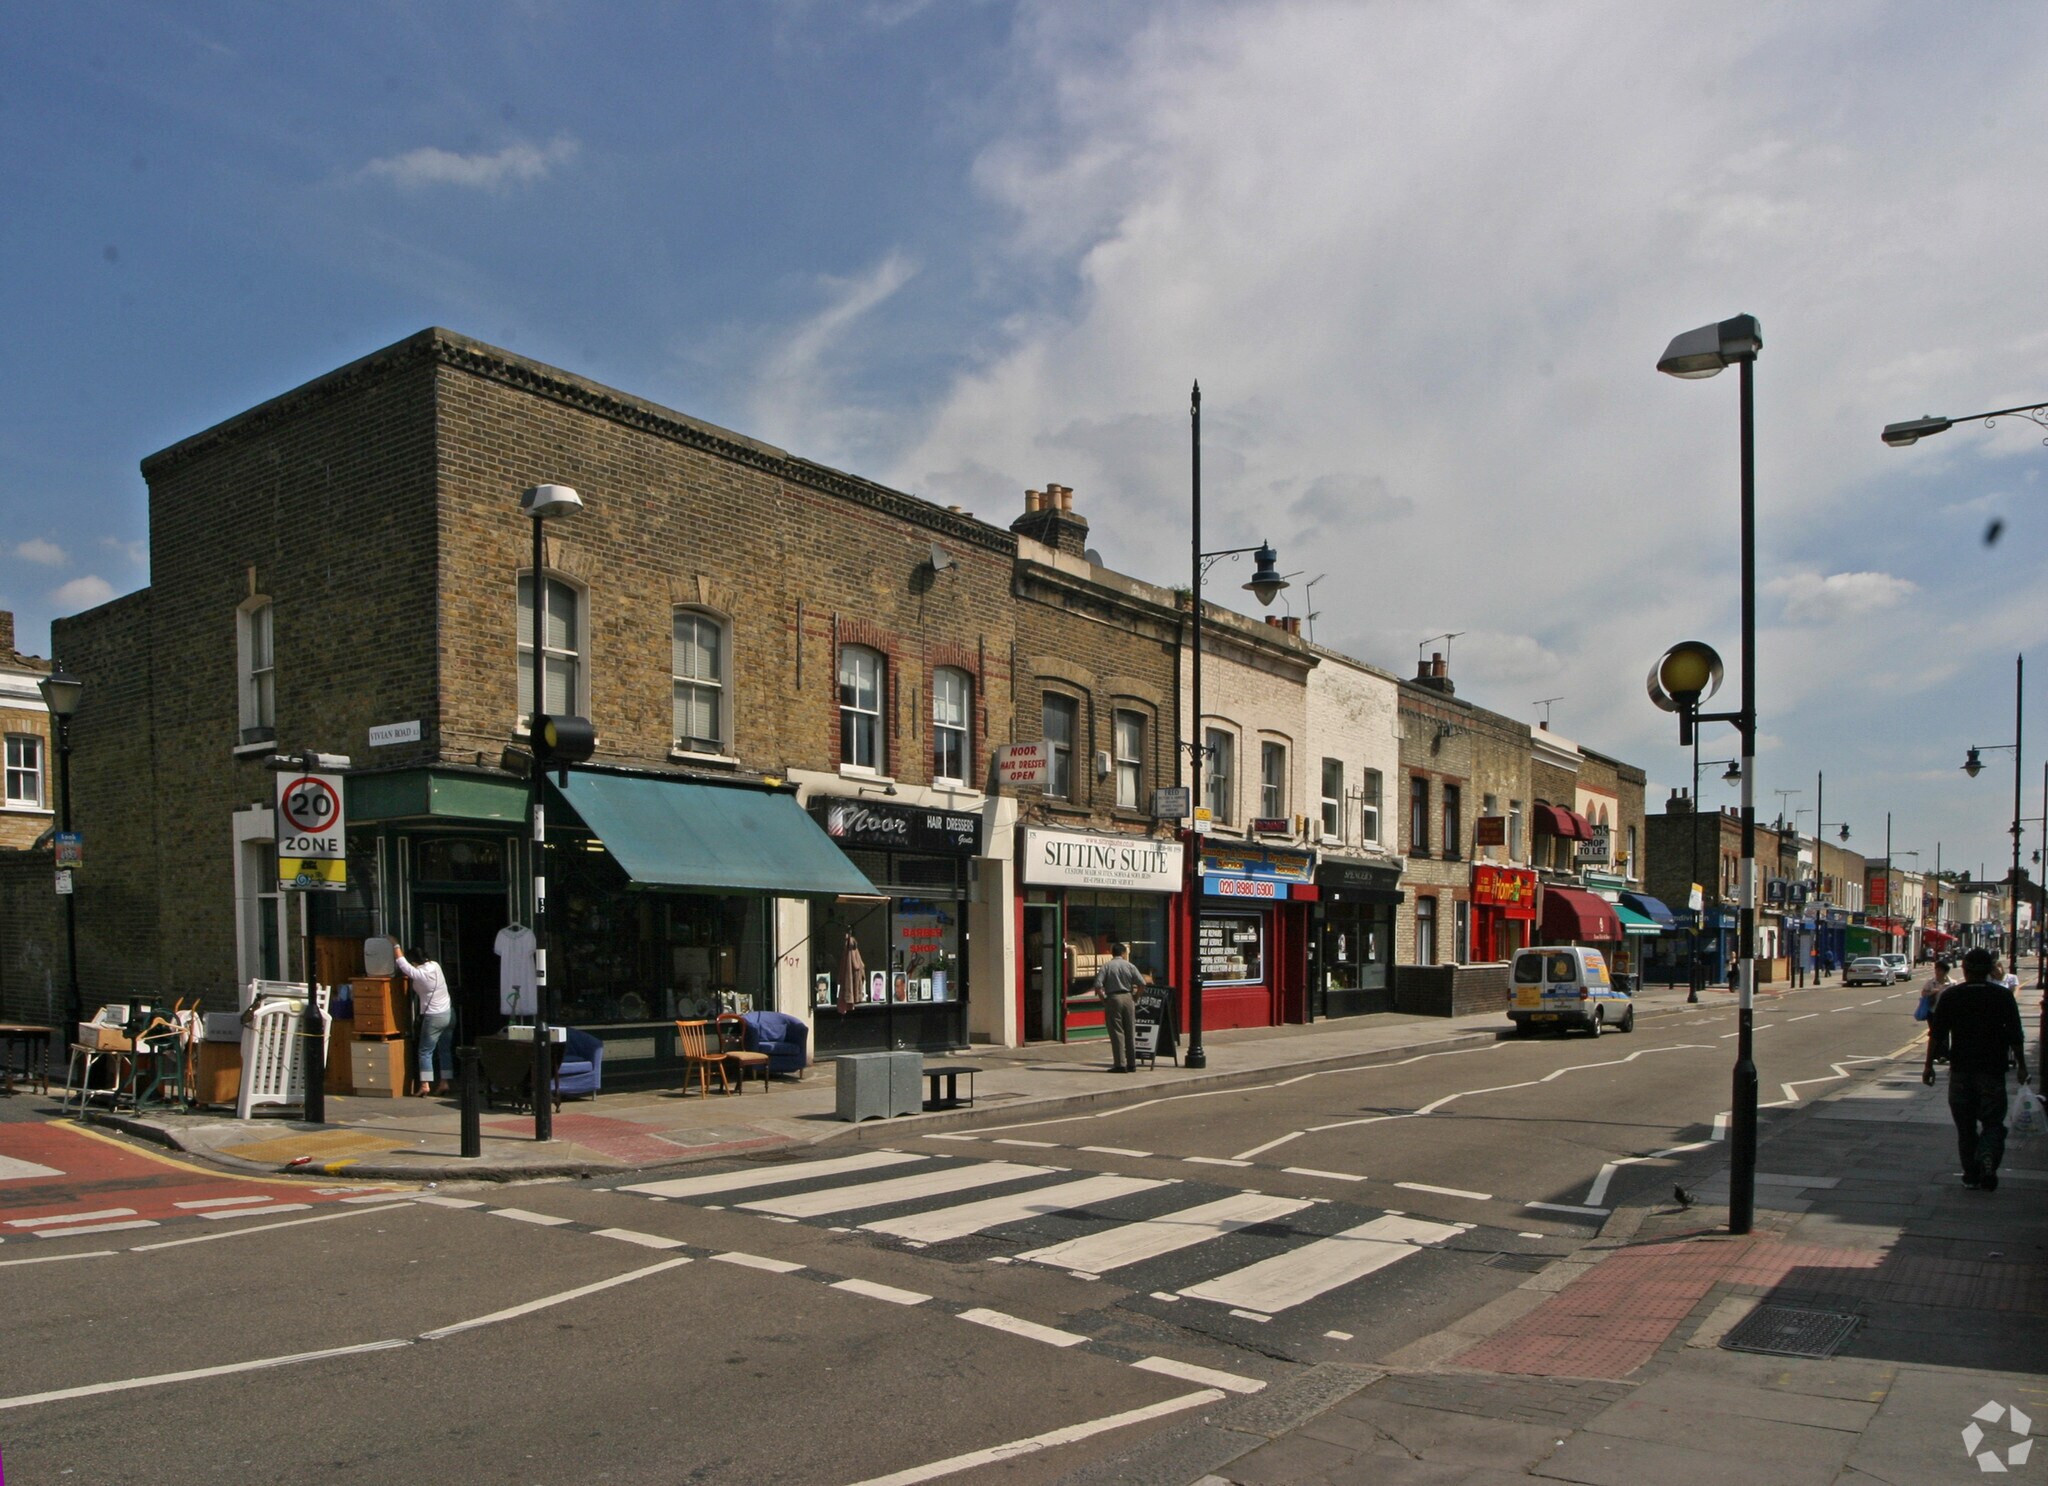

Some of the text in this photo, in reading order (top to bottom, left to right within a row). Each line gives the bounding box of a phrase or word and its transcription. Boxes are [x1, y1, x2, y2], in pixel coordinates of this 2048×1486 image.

[370, 730, 393, 741] VIVIAN
[395, 728, 411, 738] ROAD
[1010, 746, 1037, 756] NOOR
[1000, 759, 1046, 769] HAIR DRESSER
[1010, 771, 1035, 780] OPEN
[292, 793, 331, 816] 20
[842, 806, 907, 833] Noor
[926, 815, 974, 833] HAIR DRESSERS
[285, 837, 338, 851] ZONE
[1582, 839, 1604, 847] SHOP
[1044, 841, 1168, 873] SITTING SUITE
[1220, 880, 1274, 896] 020 8980 6900
[903, 928, 942, 938] BARBER
[910, 944, 937, 952] SHOP
